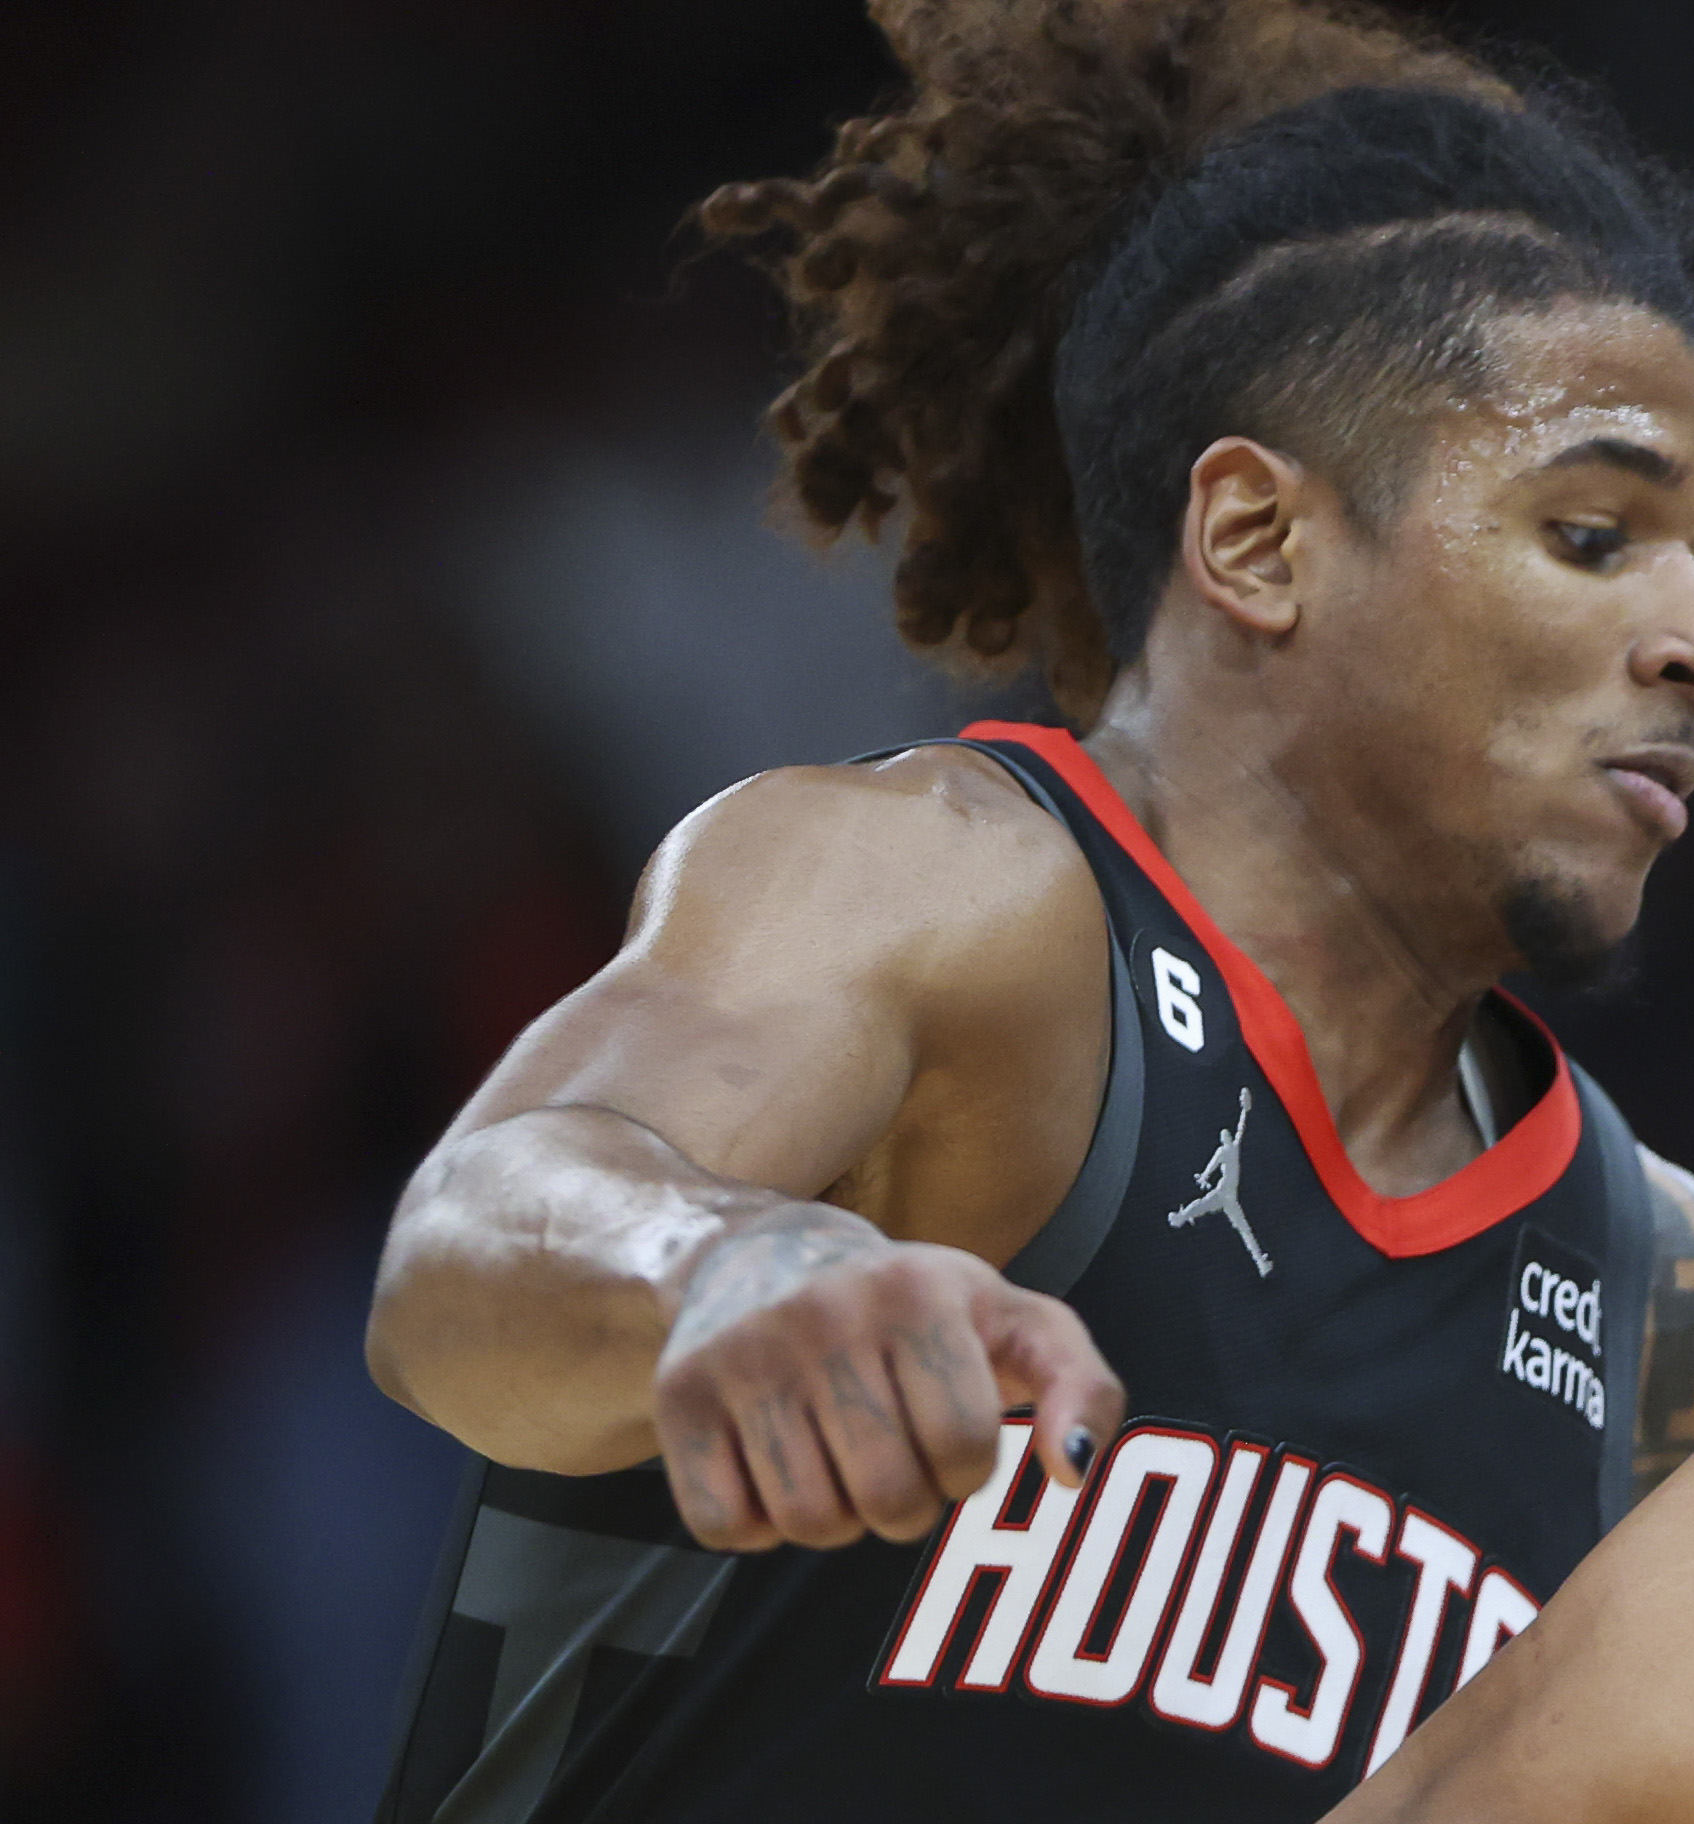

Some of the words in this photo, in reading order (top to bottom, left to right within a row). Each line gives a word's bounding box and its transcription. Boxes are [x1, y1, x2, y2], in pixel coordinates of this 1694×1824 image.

[1151, 947, 1204, 1052] 6
[1520, 1262, 1602, 1356] cred
[1503, 1308, 1605, 1430] karma
